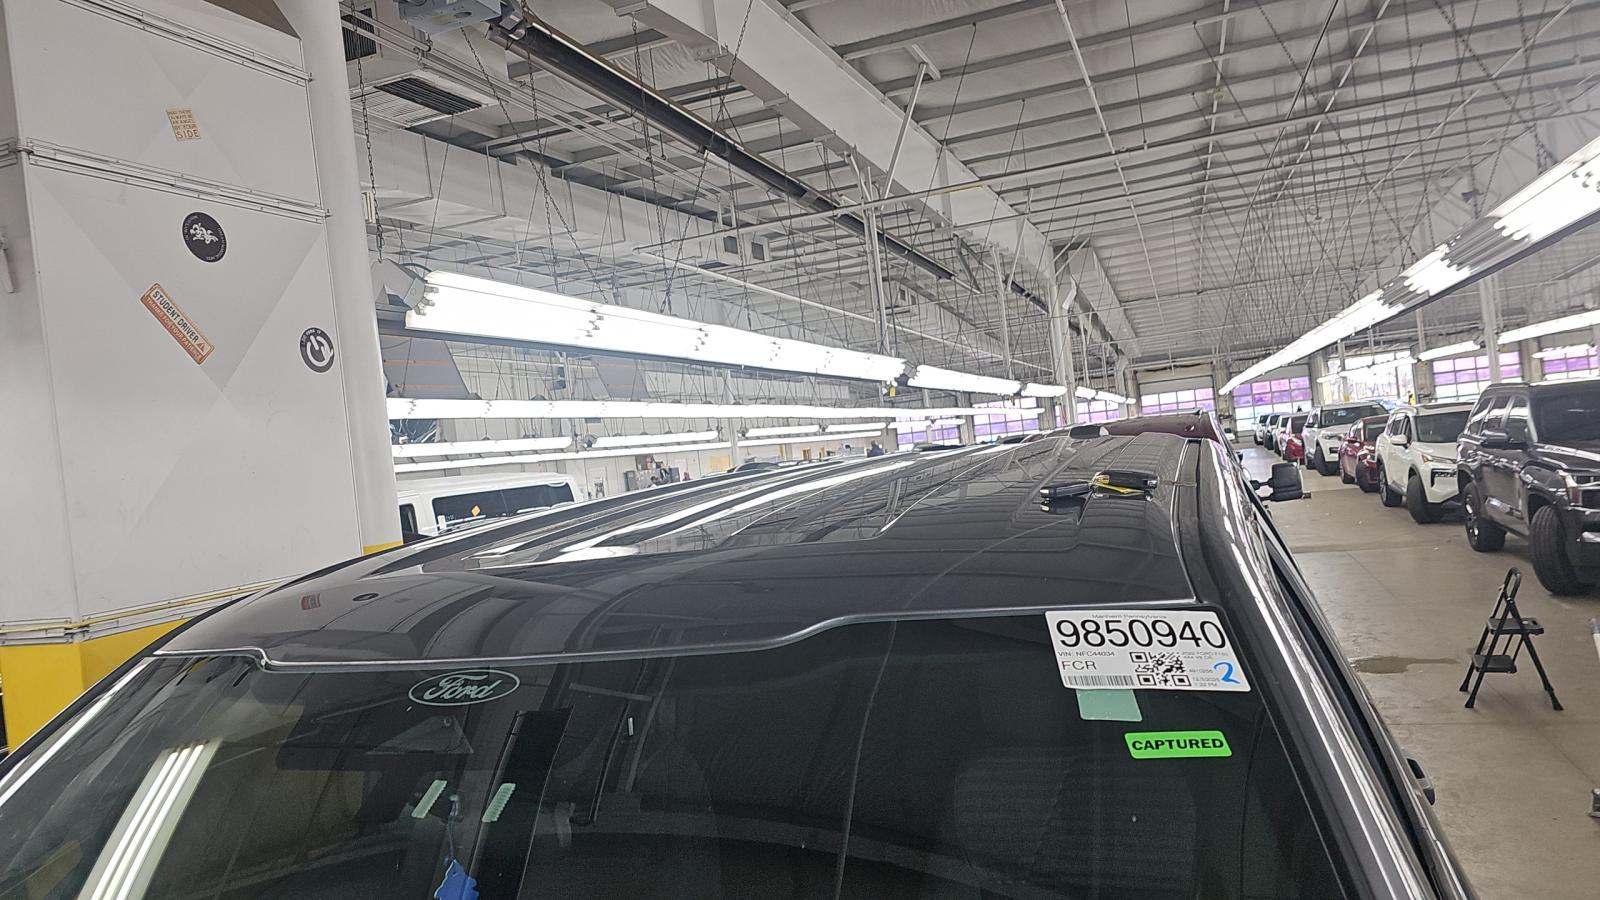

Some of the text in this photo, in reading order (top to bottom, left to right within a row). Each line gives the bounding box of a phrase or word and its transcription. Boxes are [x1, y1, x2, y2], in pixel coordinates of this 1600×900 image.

[176, 129, 200, 139] SIDE
[153, 290, 199, 343] STUDENT DRIVER
[1056, 619, 1226, 648] 9850940
[1062, 660, 1097, 671] FCR
[1213, 661, 1241, 684] 2
[423, 674, 503, 700] Ford
[1132, 738, 1224, 751] CAPTURED
